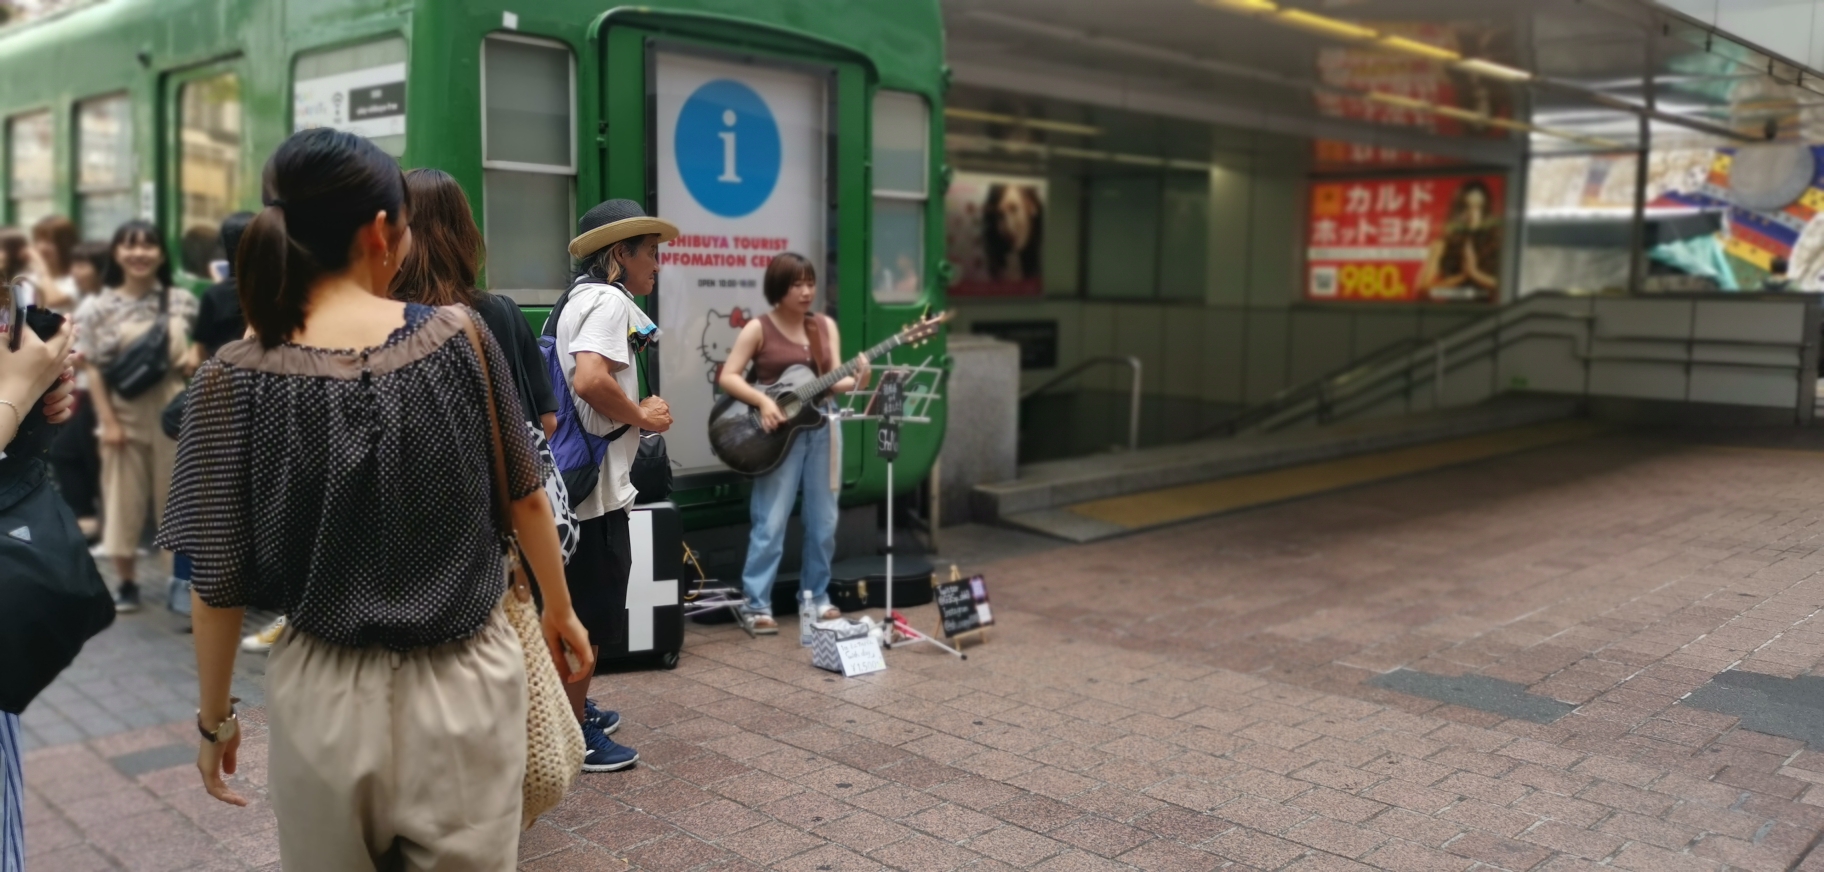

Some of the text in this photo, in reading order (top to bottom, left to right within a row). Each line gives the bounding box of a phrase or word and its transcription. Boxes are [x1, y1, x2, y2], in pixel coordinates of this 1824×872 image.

[717, 109, 742, 183] i
[1345, 182, 1434, 213] カルド
[667, 235, 788, 250] SHIBUYA TOURIST
[1312, 216, 1430, 244] ホットヨガ
[698, 279, 716, 288] OPEN
[1341, 264, 1407, 297] 980
